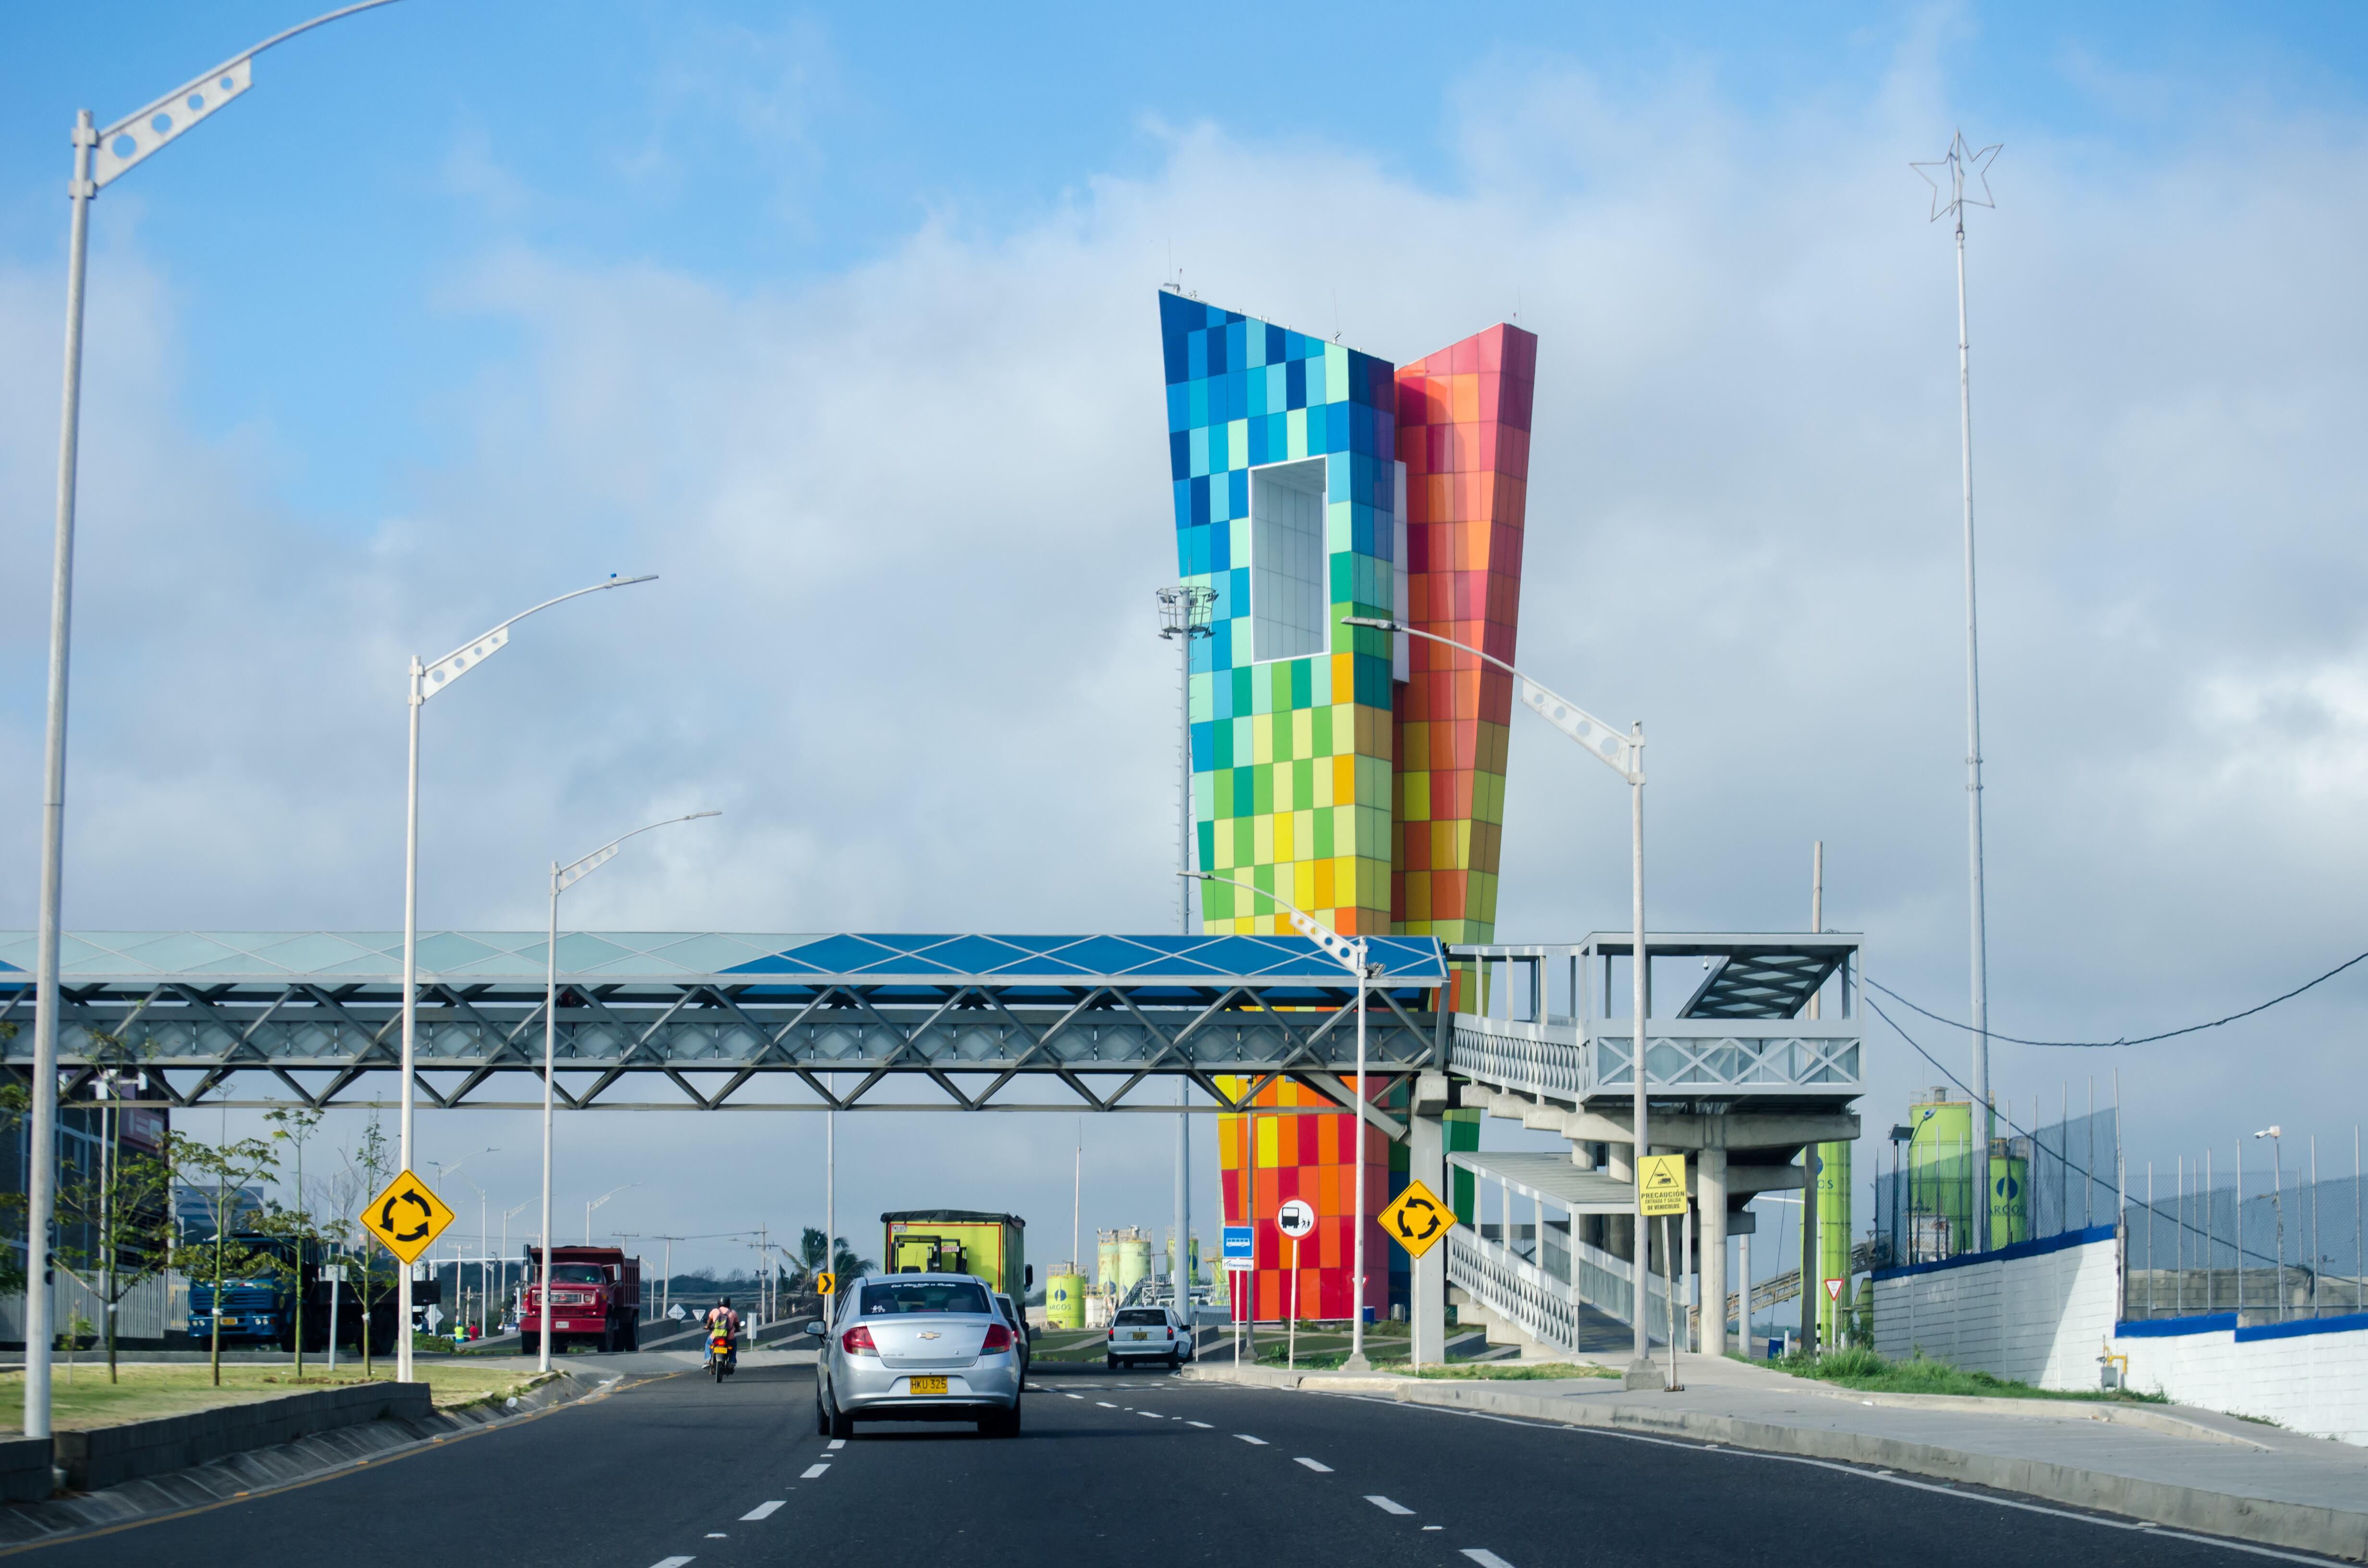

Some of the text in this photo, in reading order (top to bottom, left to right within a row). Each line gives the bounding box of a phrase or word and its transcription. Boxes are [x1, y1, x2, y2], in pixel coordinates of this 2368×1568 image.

[1641, 1189, 1685, 1199] PRECAUCIÓN
[911, 1379, 947, 1389] HKU 325
